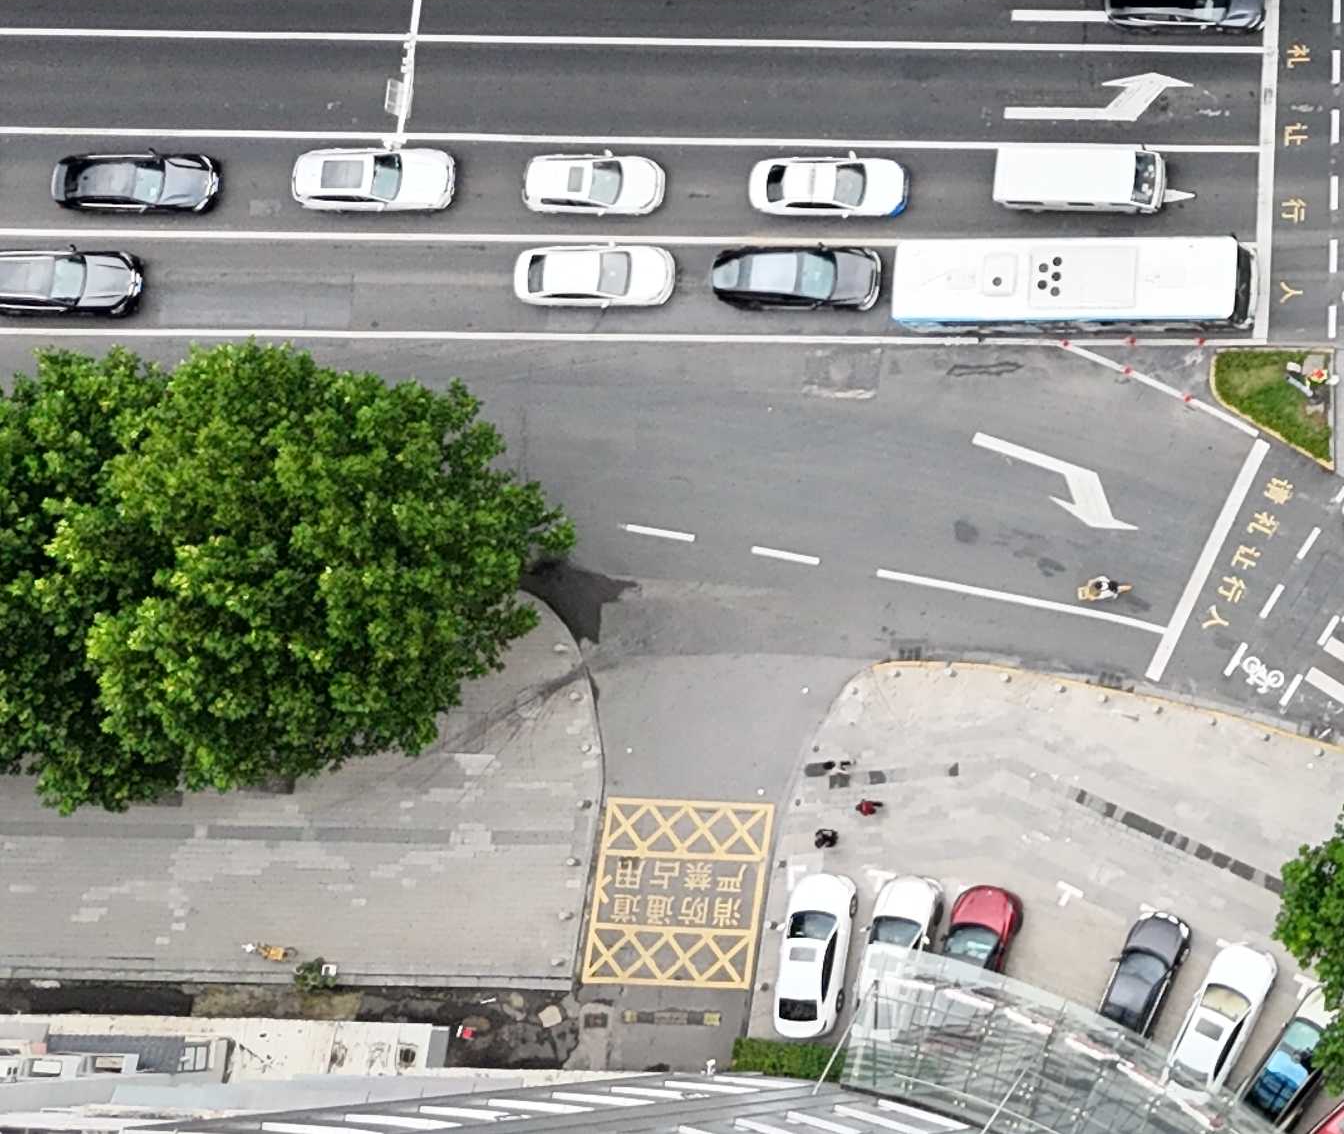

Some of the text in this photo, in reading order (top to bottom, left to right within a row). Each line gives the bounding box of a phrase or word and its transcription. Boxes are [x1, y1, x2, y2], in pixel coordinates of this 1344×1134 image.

[1201, 477, 1294, 629] 请礼让行人
[614, 859, 748, 892] 严禁占用
[610, 893, 743, 927] 消防通道
